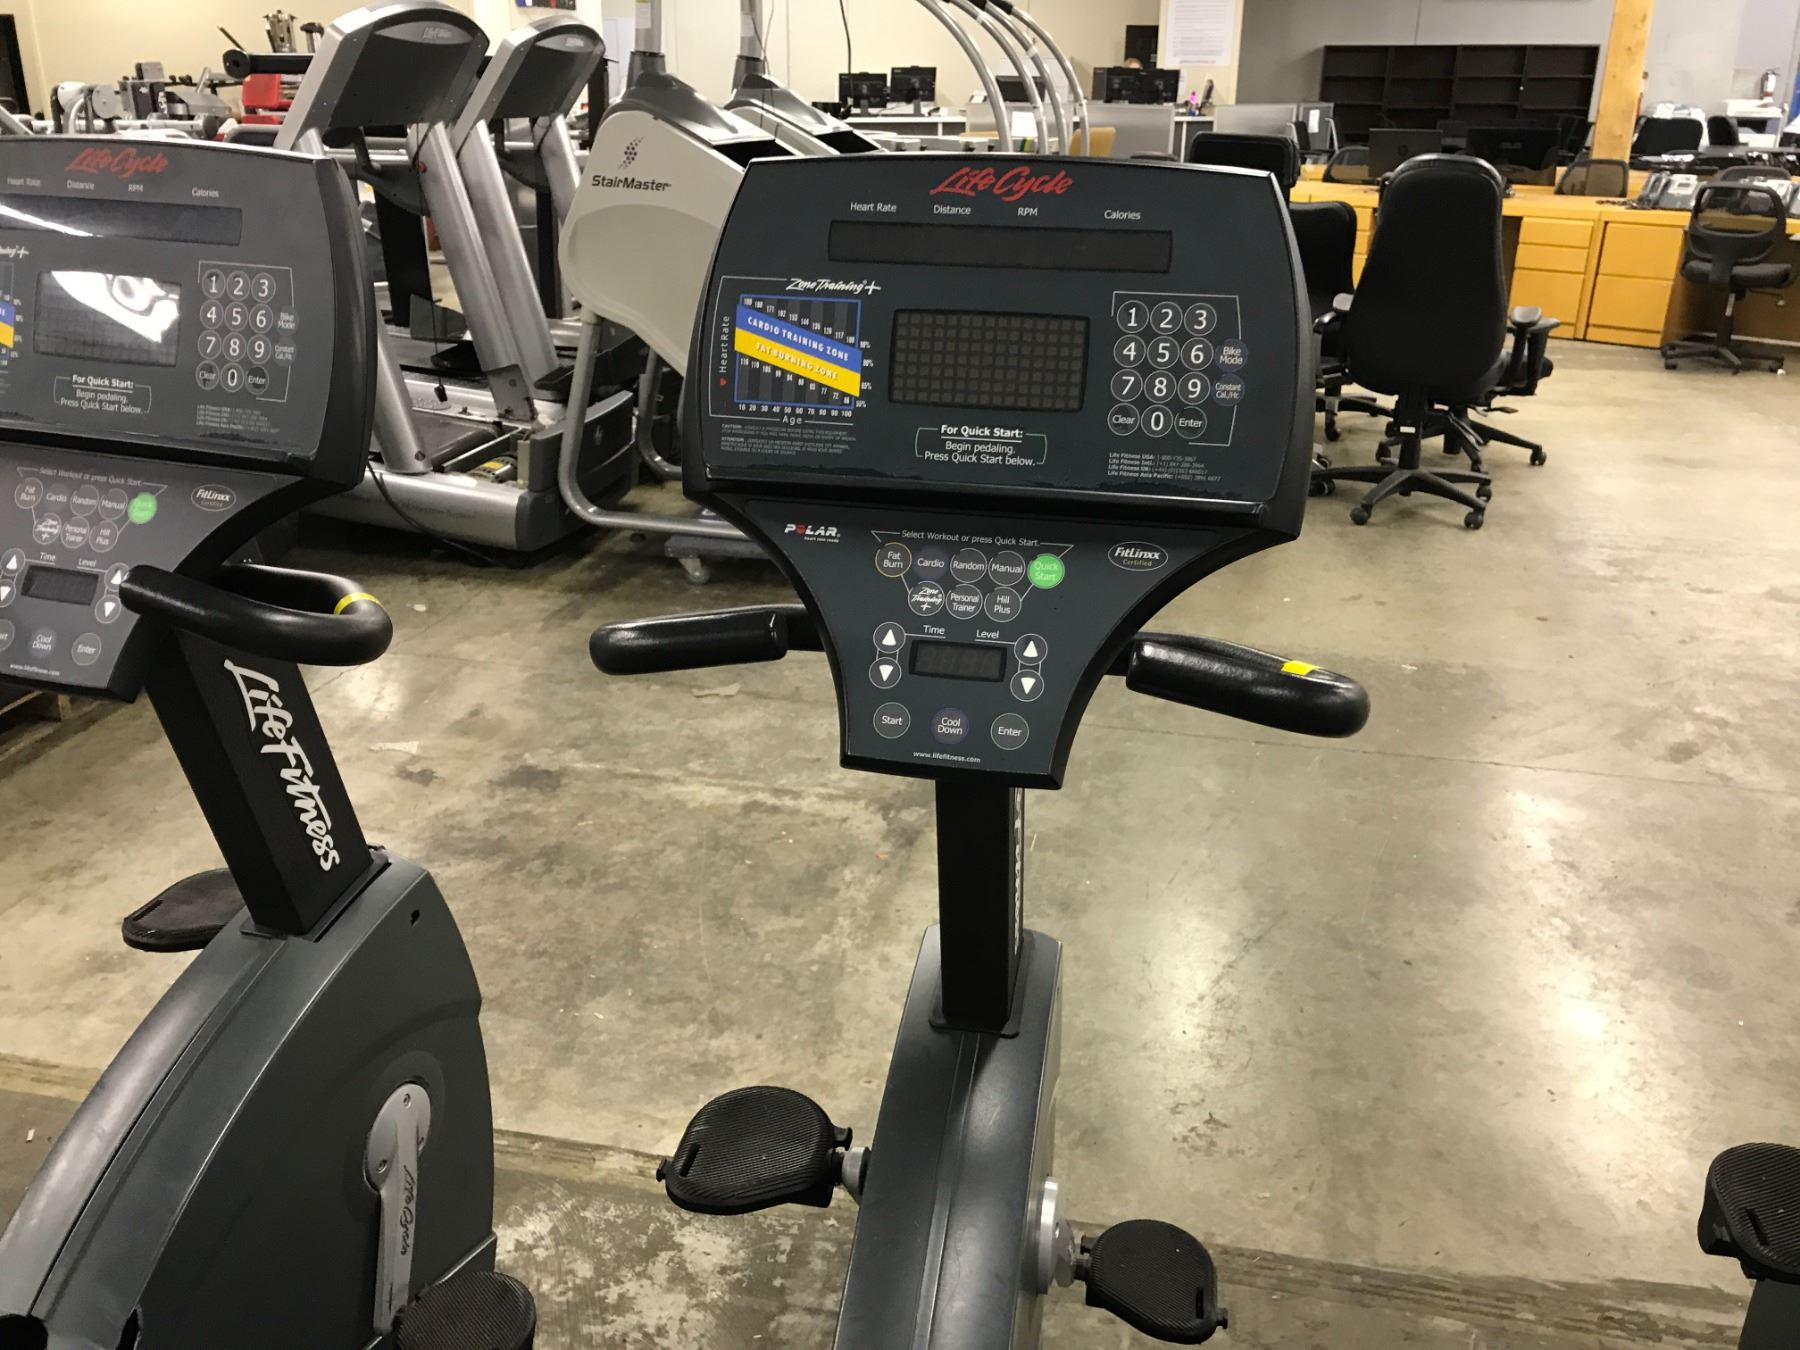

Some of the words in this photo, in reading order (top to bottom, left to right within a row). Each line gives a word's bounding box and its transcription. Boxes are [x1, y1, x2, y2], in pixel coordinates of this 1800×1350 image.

[67, 179, 95, 190] Distance
[128, 183, 144, 193] RPM
[592, 175, 669, 191] StairMaster
[929, 166, 995, 197] Life
[993, 166, 1073, 202] Cycle
[191, 186, 220, 198] Calories
[850, 202, 875, 212] Heart
[876, 202, 897, 213] Rate
[933, 204, 971, 215] Distance
[1017, 207, 1038, 217] RPM
[1104, 210, 1141, 220] Calories
[209, 275, 218, 293] 1
[233, 277, 244, 295] 2
[258, 279, 269, 297] 3
[206, 306, 217, 323] 4
[231, 308, 241, 326] 5
[256, 310, 266, 328] 6
[1127, 307, 1138, 327] 1
[1159, 308, 1173, 329] 2
[1193, 310, 1207, 330] 3
[720, 316, 730, 340] Rate
[747, 316, 779, 335] CARDIO
[781, 329, 824, 352] TRAINING
[825, 346, 849, 362] ZONE
[206, 336, 216, 354] 7
[229, 338, 240, 356] 8
[254, 340, 264, 359] 9
[1122, 341, 1137, 361] 4
[1156, 343, 1171, 362] 5
[1190, 344, 1204, 364] 6
[1222, 346, 1242, 356] Bike
[719, 342, 729, 373] Heart
[755, 342, 770, 353] FAT
[773, 350, 814, 371] BURNING
[815, 365, 839, 380] ZONE
[1219, 355, 1243, 365] Mode
[72, 374, 86, 383] For
[87, 376, 110, 386] Quick
[111, 378, 134, 389] Start:
[199, 371, 216, 380] Clear
[227, 368, 238, 387] 0
[248, 375, 266, 385] Enter
[1121, 376, 1135, 395] 7
[1153, 377, 1167, 397] 8
[1187, 378, 1201, 399] 9
[1215, 383, 1242, 391] Constant
[76, 389, 96, 400] Begin
[96, 392, 128, 403] pedaling.
[60, 397, 79, 407] Press
[80, 399, 100, 410] Quick
[101, 401, 119, 411] Start
[120, 404, 144, 414] below.
[749, 404, 757, 412] 20
[772, 405, 780, 413] 40
[784, 406, 792, 414] 50
[807, 407, 815, 415] 70
[831, 409, 839, 417] 90
[841, 409, 852, 417] 100
[782, 415, 802, 426] Age
[1112, 415, 1136, 425] Clear
[1150, 411, 1164, 431] 0
[1178, 418, 1203, 428] Enter
[941, 424, 959, 435] For
[960, 425, 990, 437] Quick
[993, 427, 1024, 438] Start:
[945, 441, 971, 453] Begin
[974, 443, 1016, 456] pedaling.
[924, 451, 949, 461] Press
[951, 452, 978, 464] Quick
[980, 454, 1003, 465] Start
[1005, 455, 1036, 466] below.
[1119, 470, 1139, 478] Fitness
[108, 476, 125, 484] Quick
[24, 485, 36, 493] Fat
[20, 492, 36, 501] Burn
[46, 492, 67, 502] Cardio
[72, 496, 97, 505] Random
[101, 499, 125, 510] Manual
[784, 523, 838, 537] POLAR
[96, 536, 109, 545] Plus
[902, 530, 925, 539] Select
[926, 531, 959, 542] Workout
[971, 535, 993, 544] press
[994, 536, 1016, 545] Quick
[40, 552, 56, 561] Time
[887, 551, 901, 560] Fat
[1114, 546, 1160, 560] FitLinxx
[78, 558, 97, 567] Level
[883, 559, 903, 569] Burn
[917, 558, 945, 568] Cardio
[953, 561, 985, 571] Random
[991, 563, 1023, 573] Manual
[1034, 561, 1058, 571] Quick
[1034, 571, 1056, 581] Start
[950, 592, 980, 603] Personal
[996, 595, 1010, 604] Hill
[952, 603, 976, 612] Trainer
[993, 604, 1011, 614] Plus
[923, 624, 945, 635] Time
[976, 629, 1000, 640] Level
[36, 634, 52, 642] Cool
[32, 641, 52, 651] Down
[77, 644, 97, 654] Enter
[881, 715, 903, 726] Start
[941, 717, 961, 727] Cool
[937, 724, 963, 736] Down
[998, 726, 1023, 737] Enter
[913, 751, 981, 763] www.lifefitness.com
